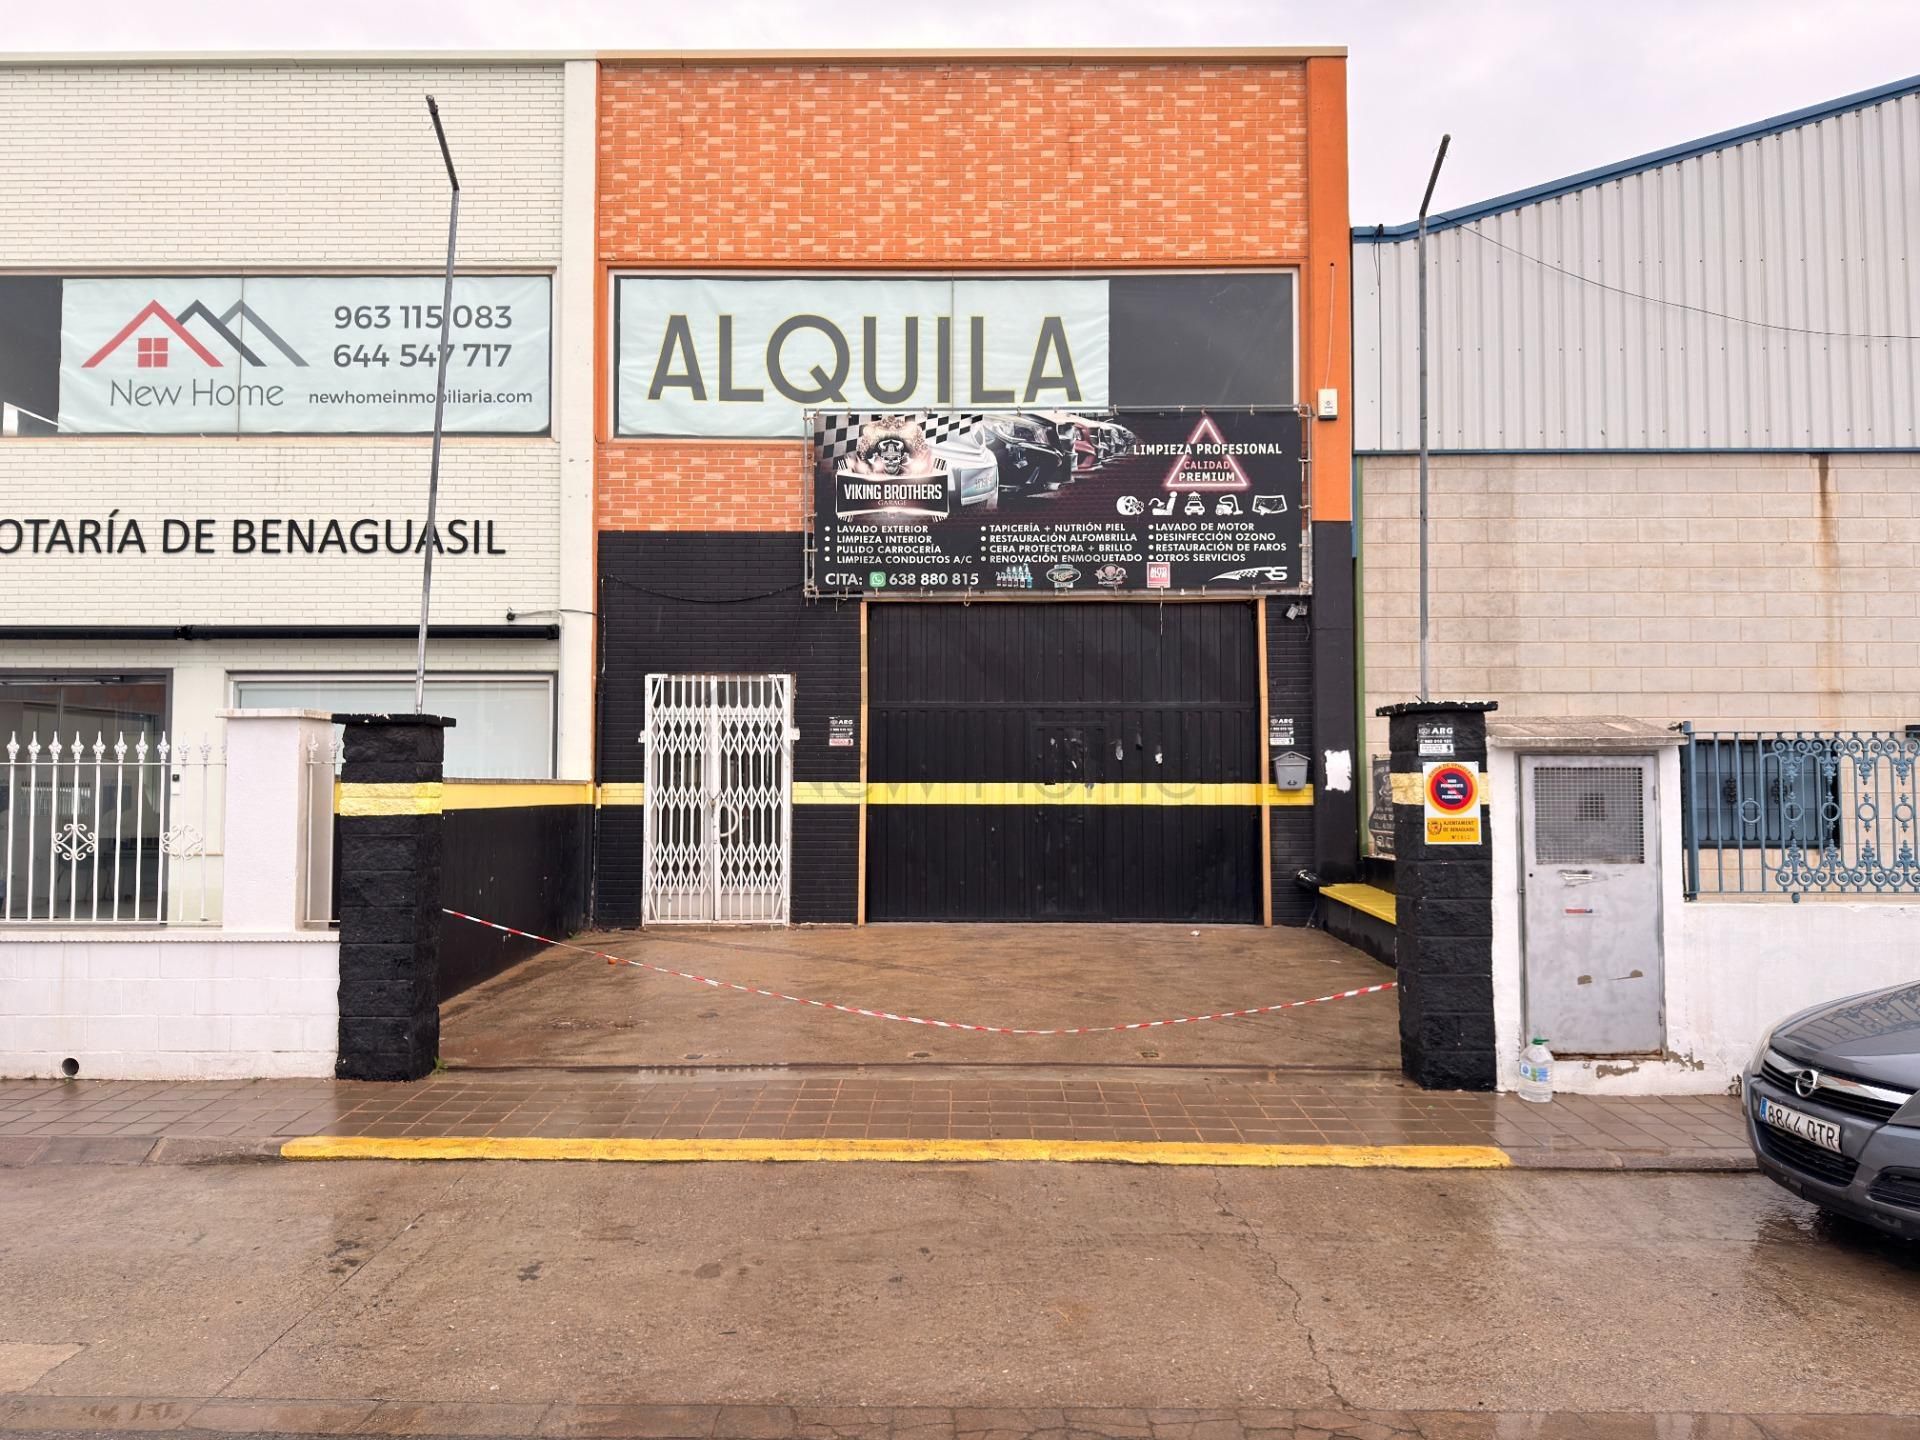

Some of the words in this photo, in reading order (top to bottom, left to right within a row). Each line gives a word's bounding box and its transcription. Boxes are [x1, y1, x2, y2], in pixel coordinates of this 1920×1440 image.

[334, 305, 391, 329] 963
[399, 305, 443, 329] 115
[453, 305, 512, 329] 083
[333, 344, 390, 368] 644
[399, 344, 455, 368] 547
[463, 344, 512, 368] 717
[647, 314, 1082, 404] ALQUILA
[110, 379, 182, 406] New
[193, 379, 284, 406] Home
[1133, 444, 1192, 456] LIMPIEZA
[1197, 443, 1282, 455] PROFESIONAL
[1184, 461, 1230, 470] CALIDAD
[1178, 472, 1235, 482] PREMIUM
[844, 484, 881, 500] VIKING
[884, 484, 942, 500] BROTHERS
[0, 509, 146, 554] OTARÍA
[162, 519, 216, 554] DE
[232, 519, 506, 554] BENAGUASIL
[837, 525, 878, 533] LAVADO
[881, 525, 928, 533] EXTERIOR
[989, 523, 1040, 532] TAPICERÍA
[1055, 522, 1102, 532] NUTRIÓN
[1105, 524, 1125, 532] PIEL
[1155, 523, 1197, 531] LAVADO
[1200, 523, 1214, 531] DE
[1217, 523, 1255, 531] MOTOR
[837, 536, 882, 544] LIMPIEZA
[885, 536, 932, 544] INTERIOR
[989, 533, 1066, 543] RESTAURACIÓN
[1070, 534, 1137, 542] ALFOMBRILLA
[1155, 532, 1232, 541] DESINFECCIÓN
[1235, 533, 1276, 541] OZONO
[837, 546, 874, 554] PULIDO
[877, 544, 941, 554] CARROCERÍA
[989, 545, 1015, 553] CERA
[1018, 545, 1084, 553] PROTECTORA
[1099, 544, 1132, 552] BRILLO
[1155, 542, 1234, 551] RESTAURACIÓN
[1237, 543, 1250, 551] DE
[1253, 543, 1287, 551] FAROS
[837, 556, 882, 564] LIMPIEZA
[885, 556, 950, 564] CONDUCTOS
[953, 556, 972, 564] A/C
[989, 553, 1058, 563] RENOVACIÓN
[1062, 554, 1143, 562] ENMOQUETADO
[1155, 553, 1190, 562] OTROS
[1193, 553, 1246, 562] SERVICIOS
[825, 573, 863, 586] CITA:
[889, 573, 916, 586] 638
[920, 573, 948, 586] 880
[952, 573, 979, 586] 815
[1768, 1105, 1803, 1136] 8844
